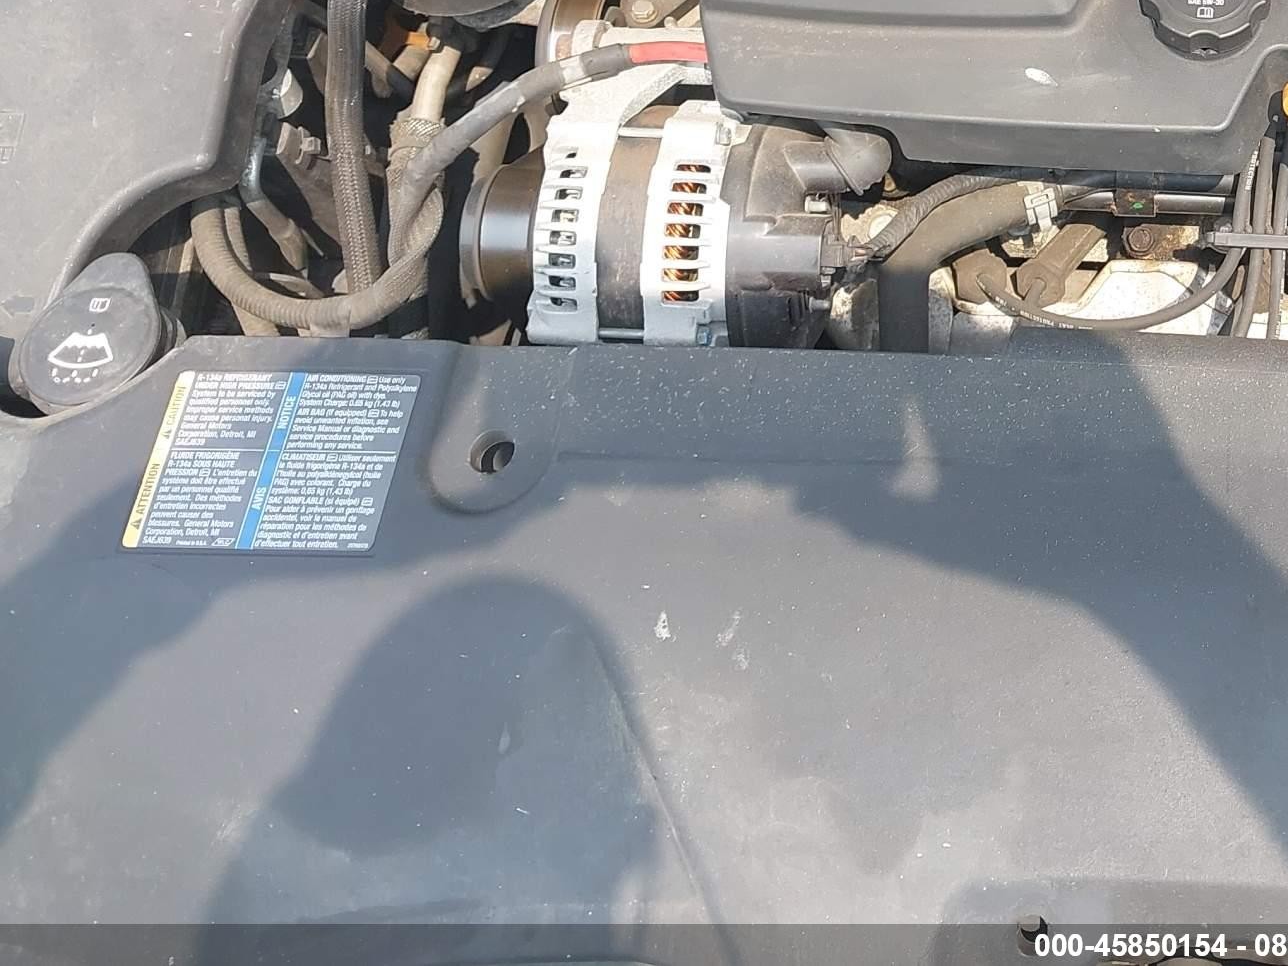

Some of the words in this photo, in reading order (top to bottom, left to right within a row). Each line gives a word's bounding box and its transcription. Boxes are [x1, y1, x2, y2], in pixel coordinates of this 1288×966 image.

[391, 377, 406, 385] only
[267, 391, 276, 399] by
[276, 396, 296, 429] NOTICE
[292, 424, 317, 432] Service
[352, 426, 385, 434] diagnostic
[314, 434, 351, 442] procedures
[192, 460, 211, 468] SOUS
[212, 460, 235, 468] HAUTE
[136, 463, 160, 513] ATTENTION
[251, 487, 267, 510] AVIS
[268, 496, 283, 504] SAC
[183, 519, 209, 527] General
